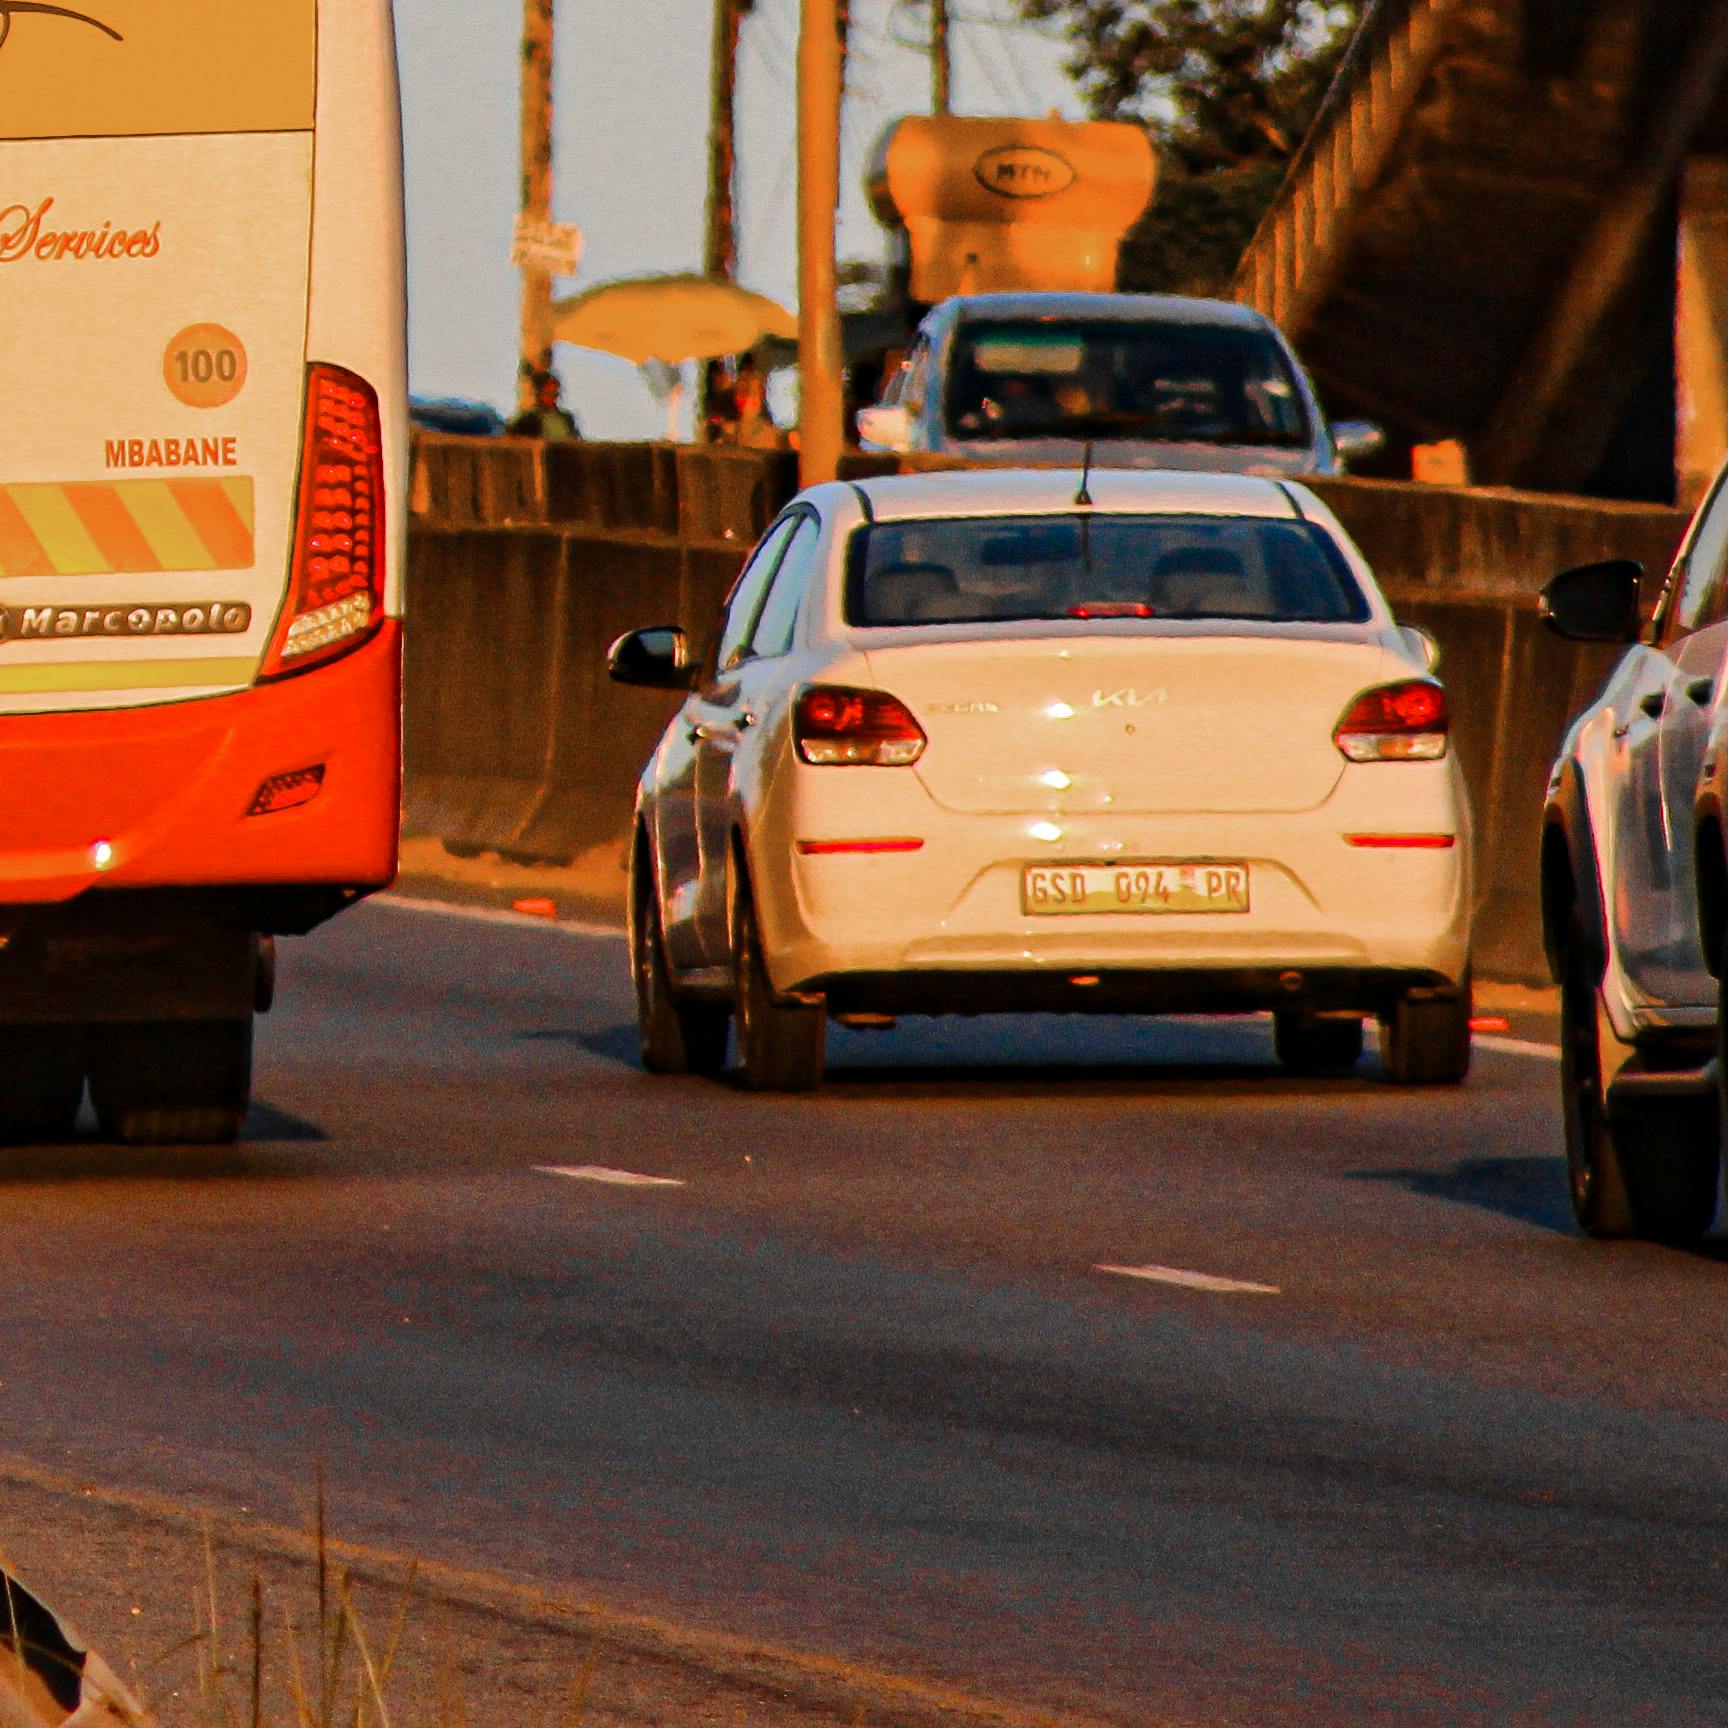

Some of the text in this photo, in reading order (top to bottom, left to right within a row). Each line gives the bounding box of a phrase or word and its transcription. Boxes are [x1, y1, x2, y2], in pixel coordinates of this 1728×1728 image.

[176, 349, 237, 383] 100
[104, 436, 238, 468] MBABANE
[20, 603, 246, 636] Marcopolo
